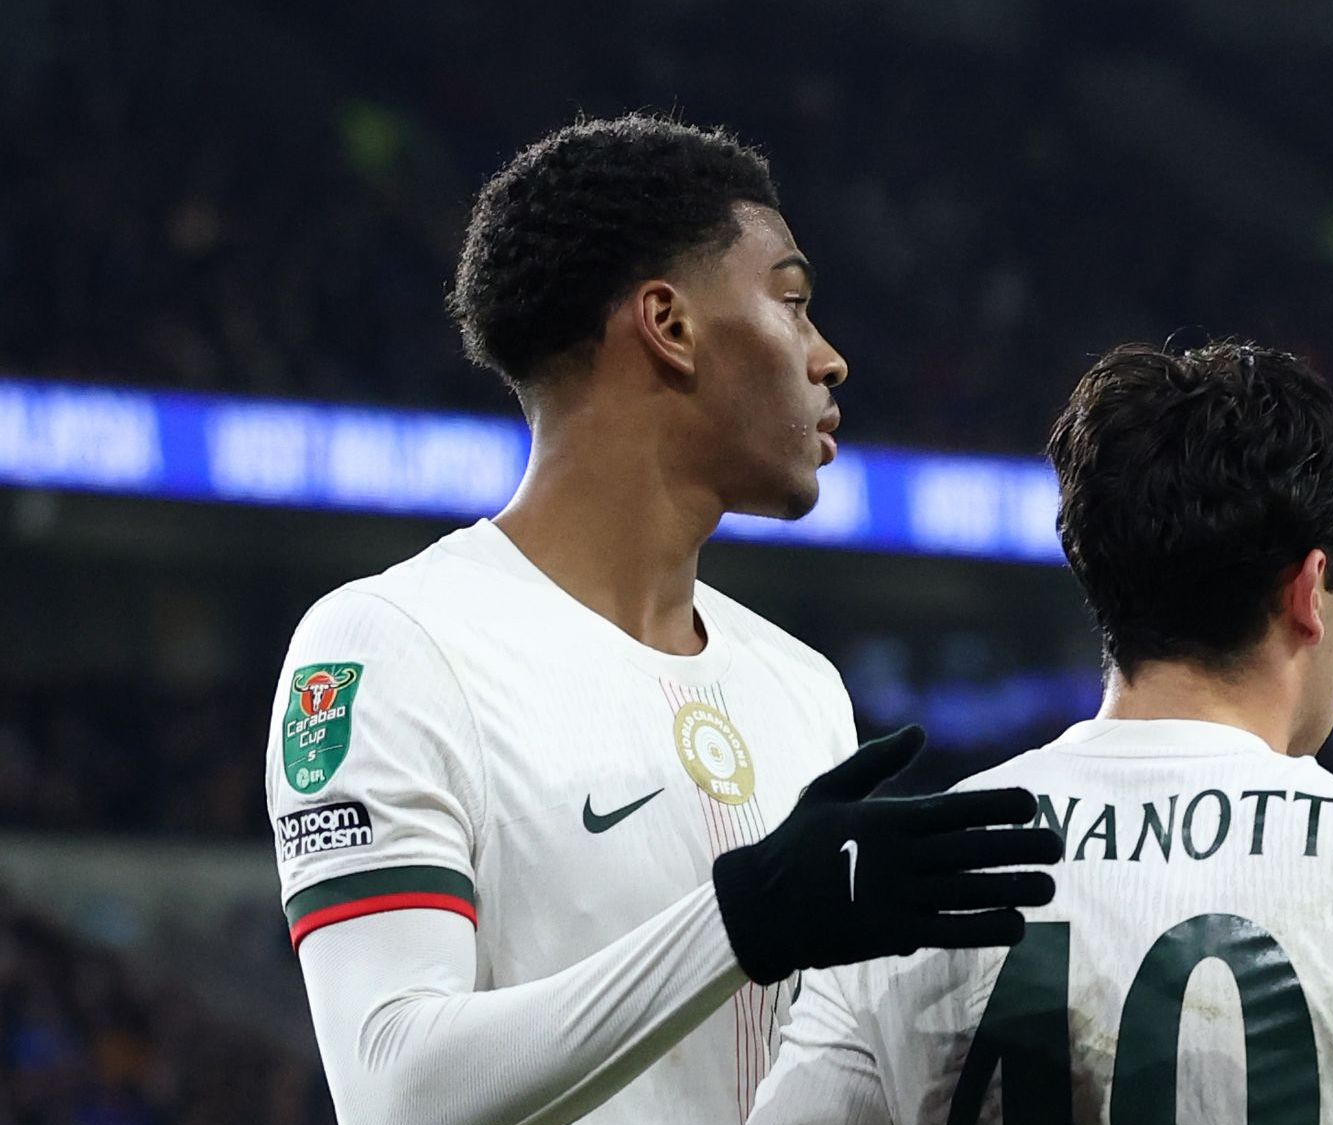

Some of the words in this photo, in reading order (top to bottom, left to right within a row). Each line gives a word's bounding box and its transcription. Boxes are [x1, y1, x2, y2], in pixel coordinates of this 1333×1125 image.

[287, 706, 346, 737] Carabao
[299, 728, 326, 748] Cup
[279, 816, 300, 840] No
[301, 807, 359, 834] room
[281, 838, 300, 862] for
[301, 826, 372, 854] racism
